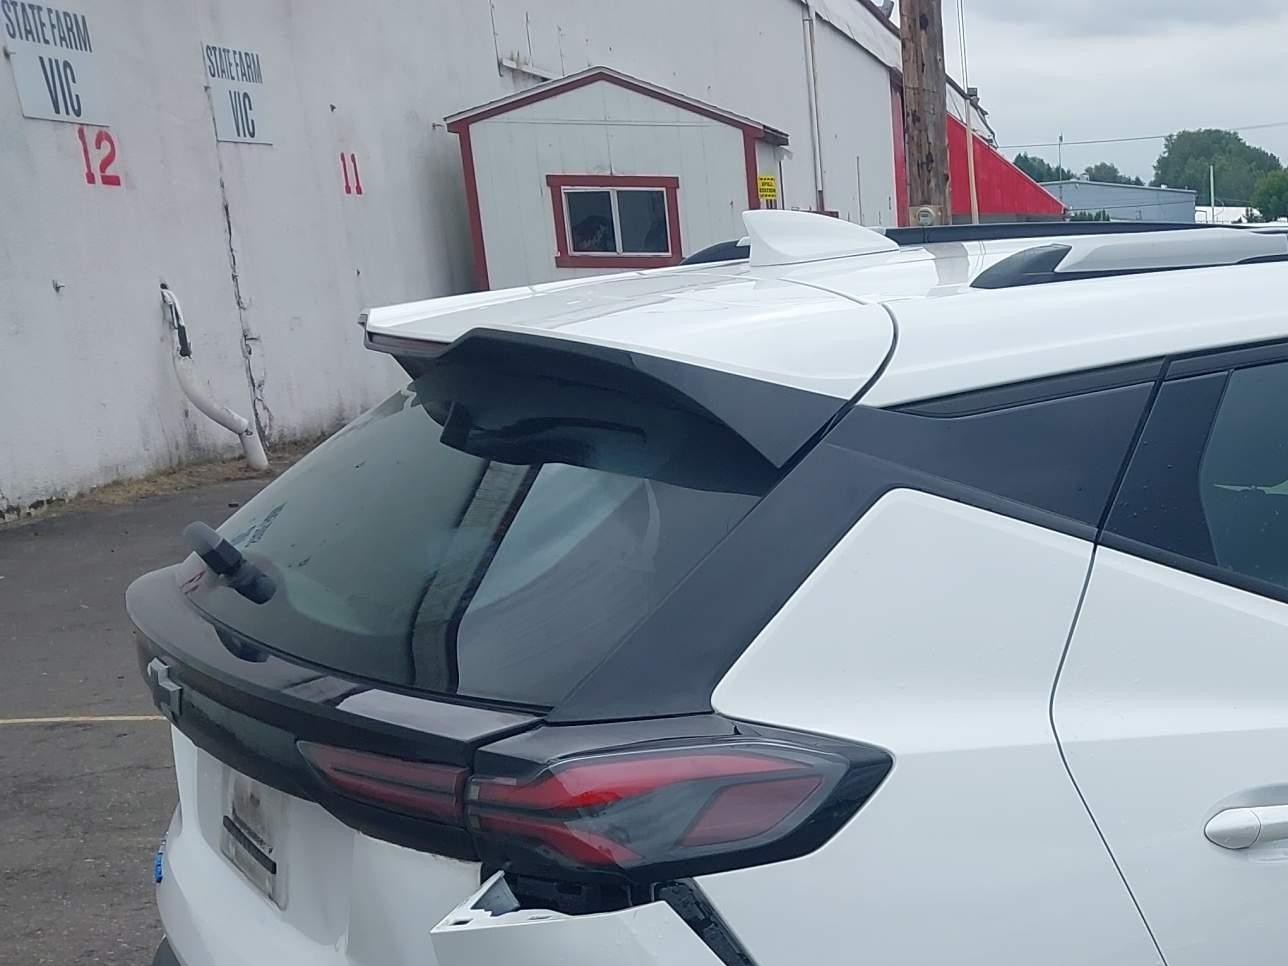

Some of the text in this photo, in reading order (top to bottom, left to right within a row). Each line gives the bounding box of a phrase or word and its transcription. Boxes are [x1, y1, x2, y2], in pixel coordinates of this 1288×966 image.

[1, 0, 93, 53] STATE FARM
[38, 55, 82, 117] VIC
[205, 44, 263, 84] STATE FARM
[228, 89, 255, 138] VIC
[77, 126, 121, 186] 12
[340, 151, 363, 195] 11
